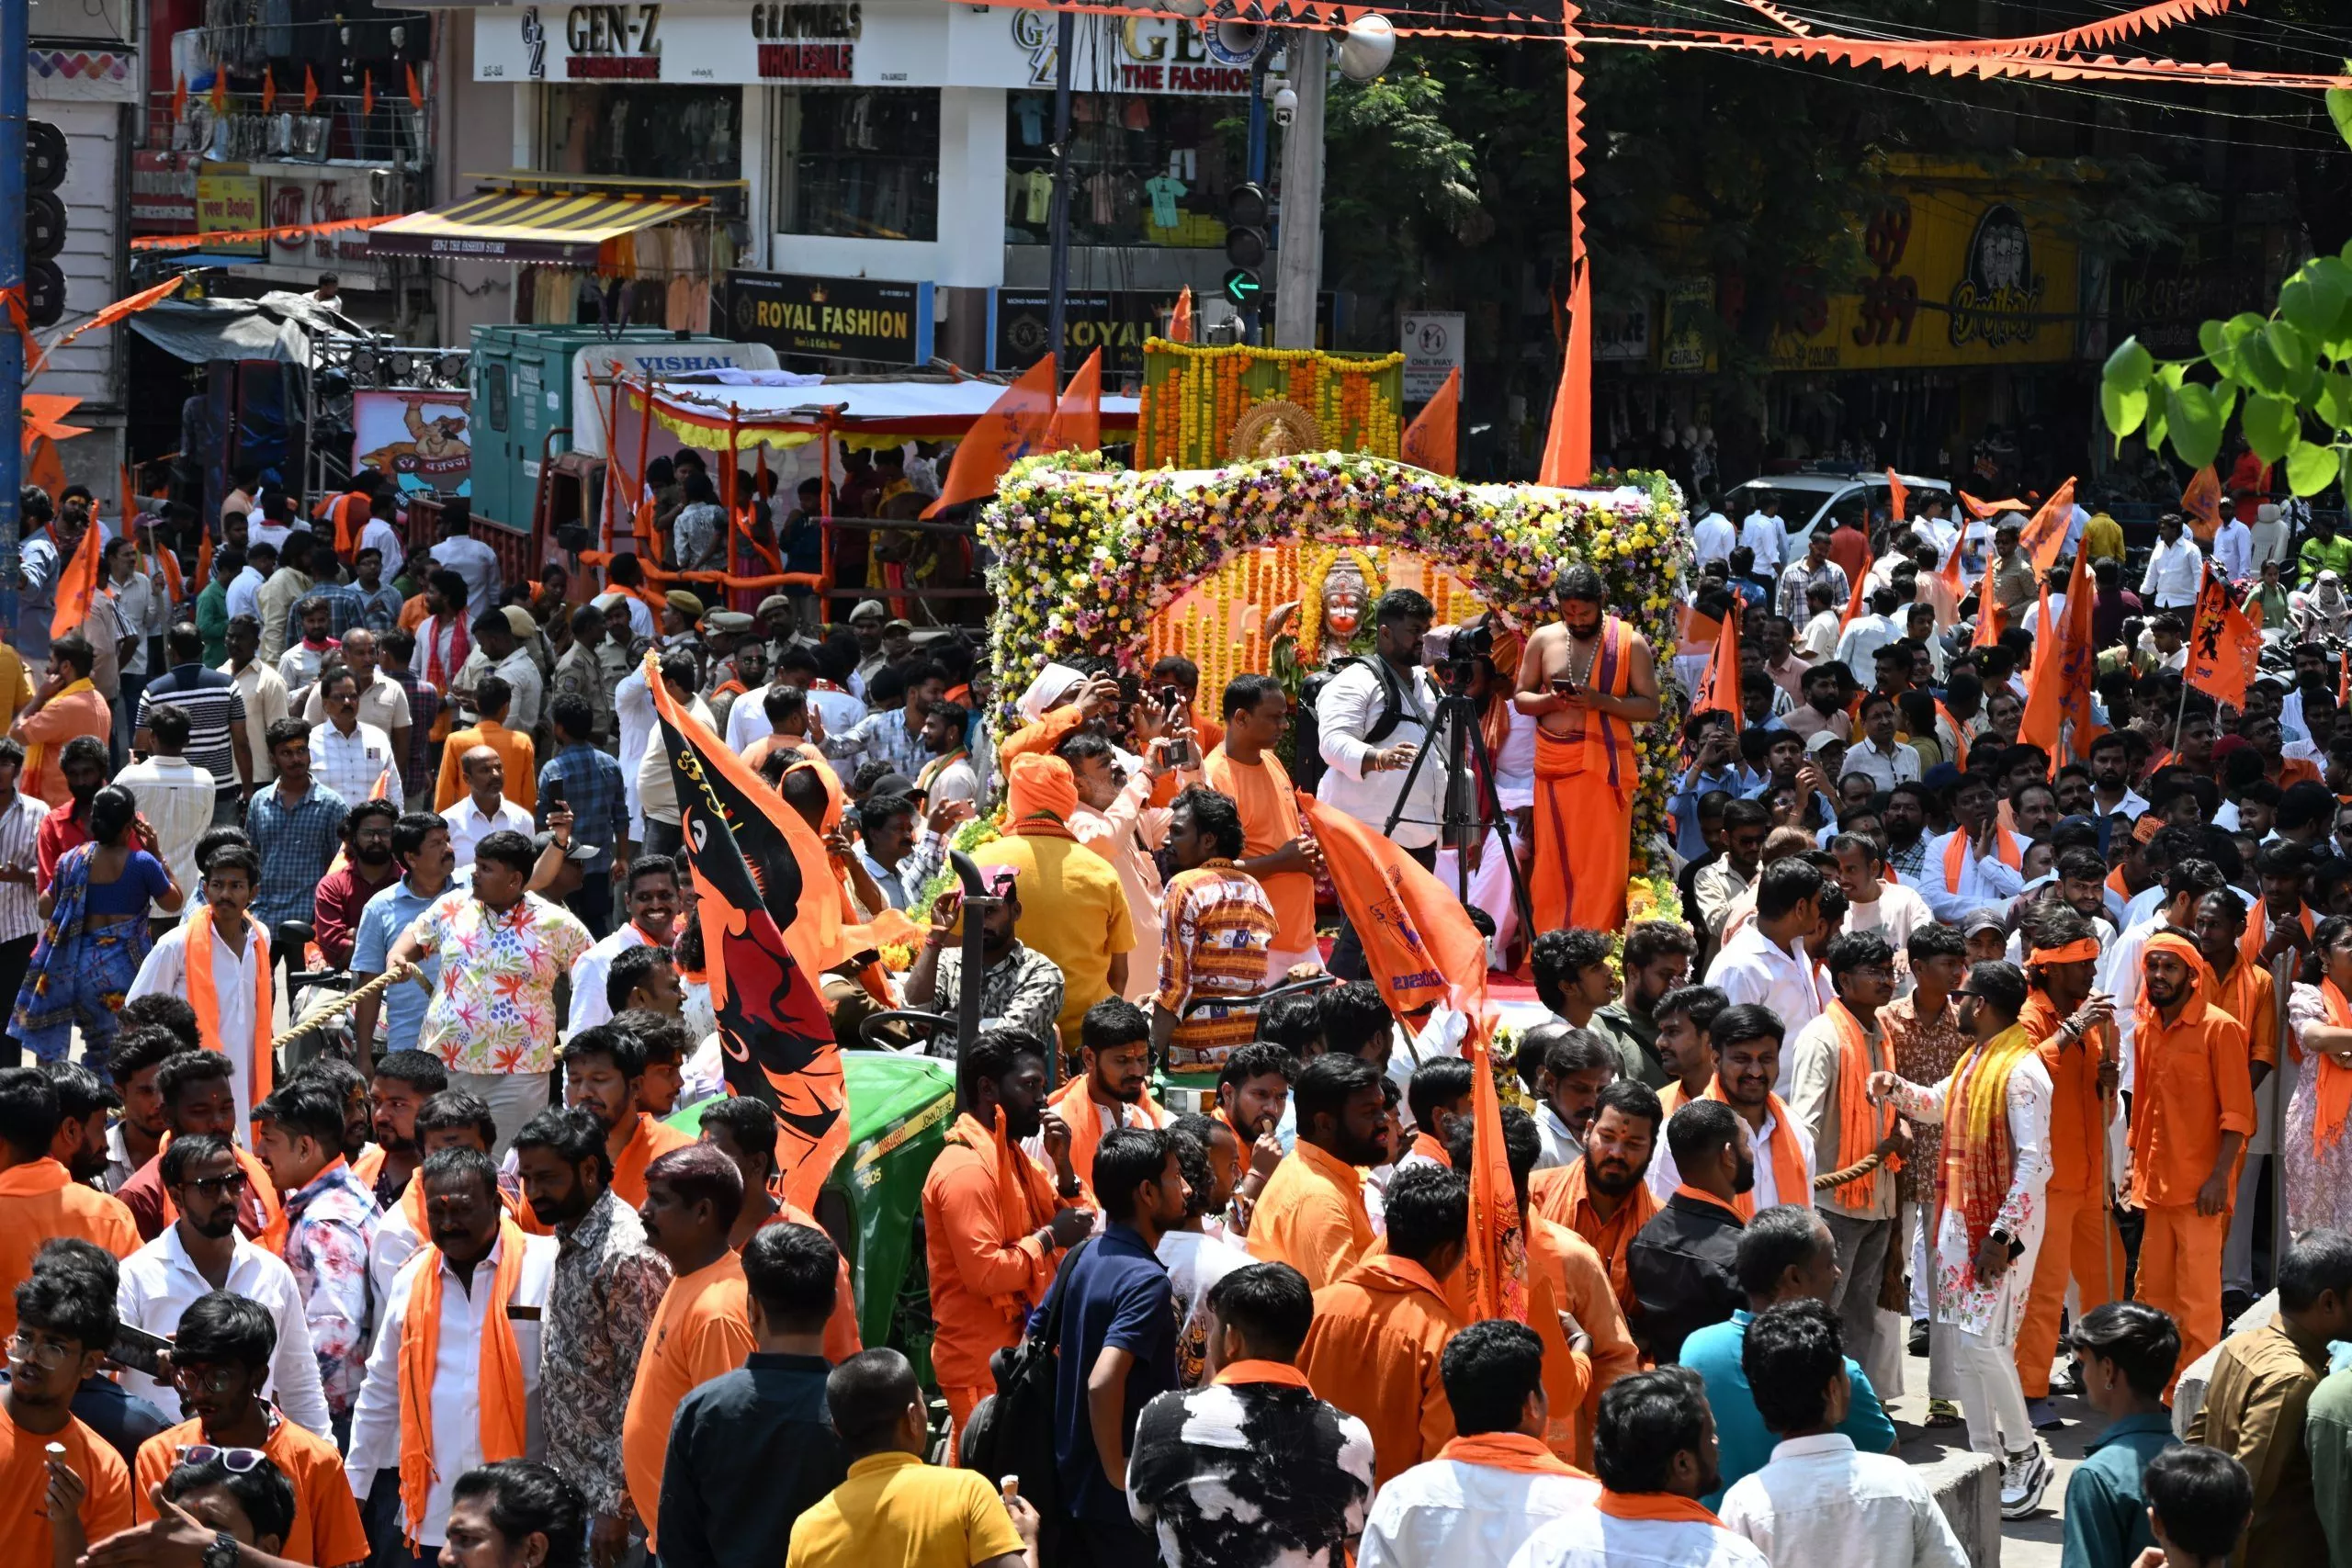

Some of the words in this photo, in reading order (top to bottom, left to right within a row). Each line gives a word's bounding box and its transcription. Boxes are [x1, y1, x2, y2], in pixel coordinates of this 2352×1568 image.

[566, 5, 662, 53] GEN-Z
[758, 44, 854, 78] WHOLESALE
[1121, 64, 1164, 89] THE
[226, 197, 254, 223] Balaji
[431, 239, 447, 252] GEN-Z
[448, 240, 460, 252] THE
[461, 241, 485, 253] FASHION
[485, 242, 505, 254] STORE
[757, 300, 817, 332] ROYAL
[821, 306, 908, 339] FASHION
[634, 355, 739, 370] VISHAL
[1411, 358, 1430, 367] ONE
[1433, 358, 1453, 367] WAY
[1668, 350, 1702, 366] GIRLS
[922, 1111, 937, 1130] JOHN
[936, 1100, 954, 1120] DEERE
